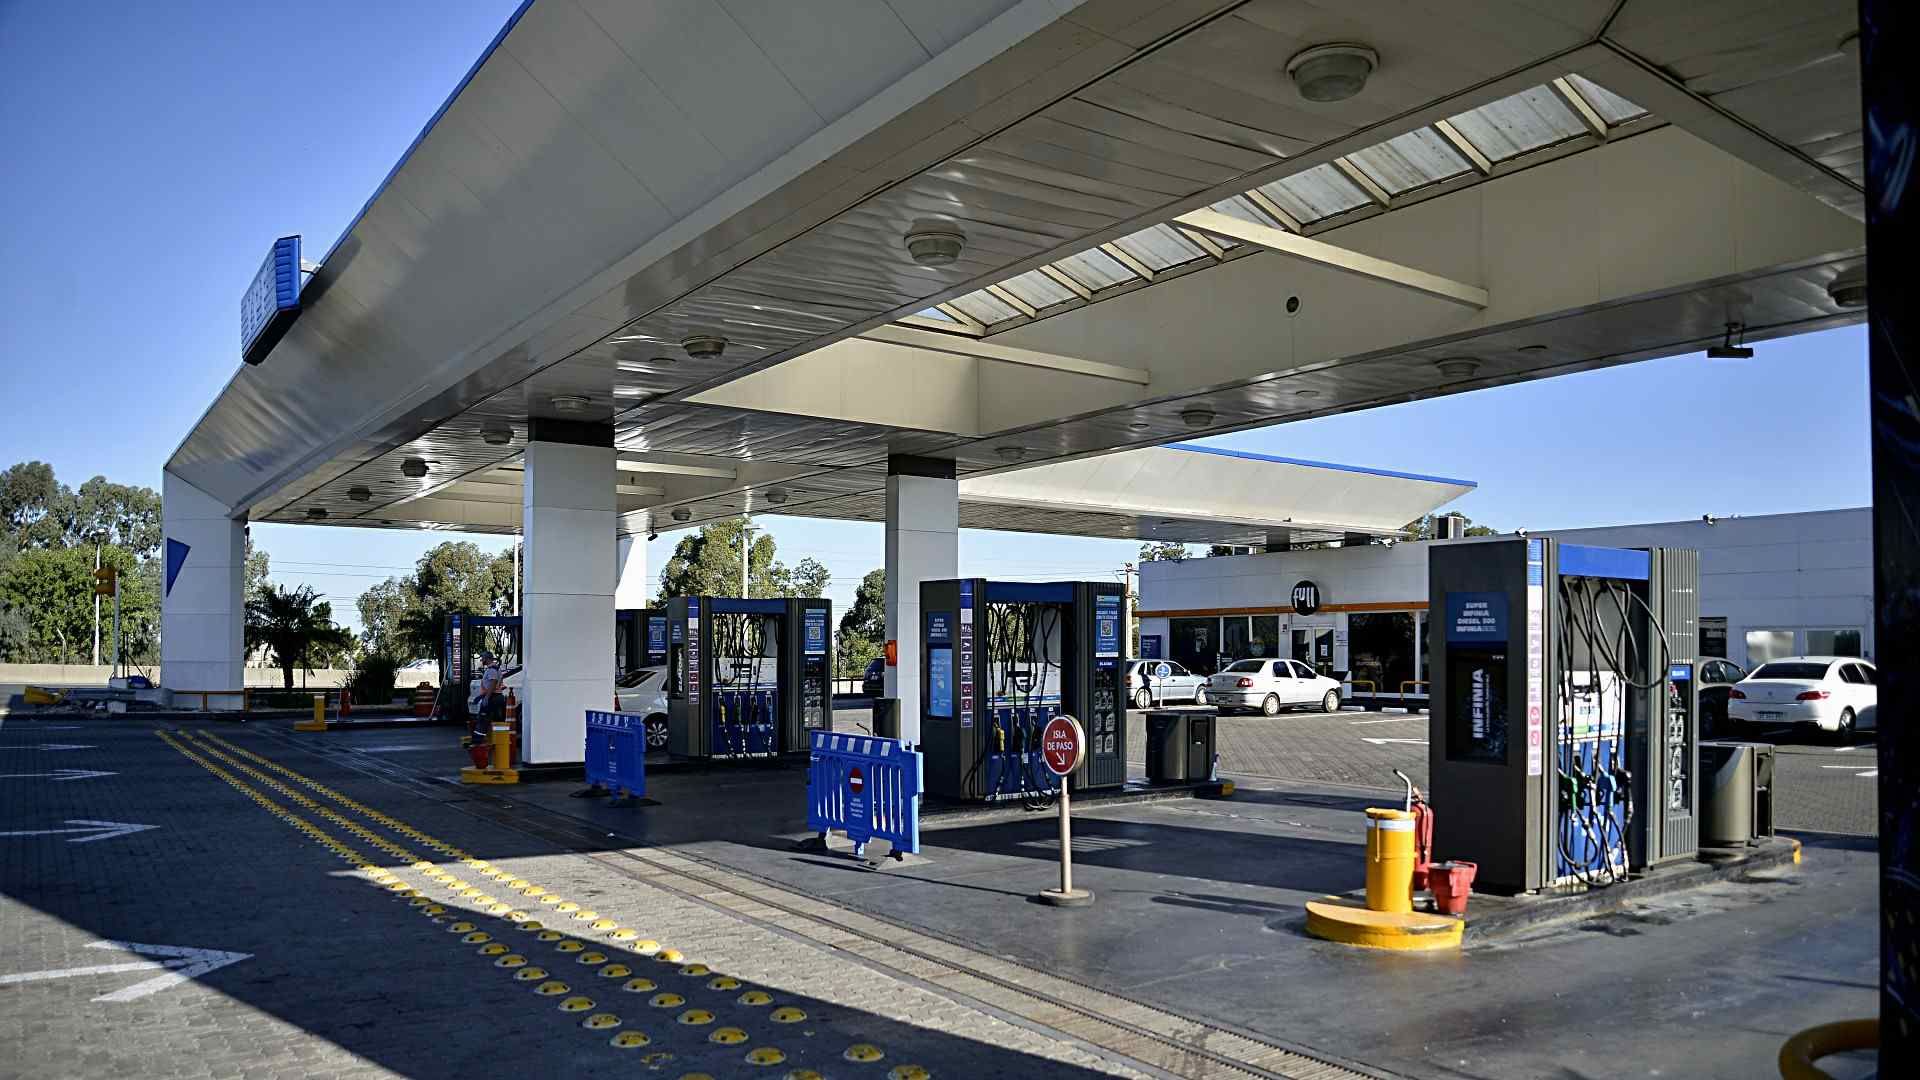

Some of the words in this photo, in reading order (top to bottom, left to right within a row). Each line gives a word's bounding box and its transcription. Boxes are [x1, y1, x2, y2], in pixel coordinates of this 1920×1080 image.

[1293, 587, 1315, 609] full
[1472, 668, 1484, 738] INFINIA
[1052, 729, 1067, 739] ISLA
[1047, 741, 1056, 751] DE
[1056, 741, 1073, 751] PASO
